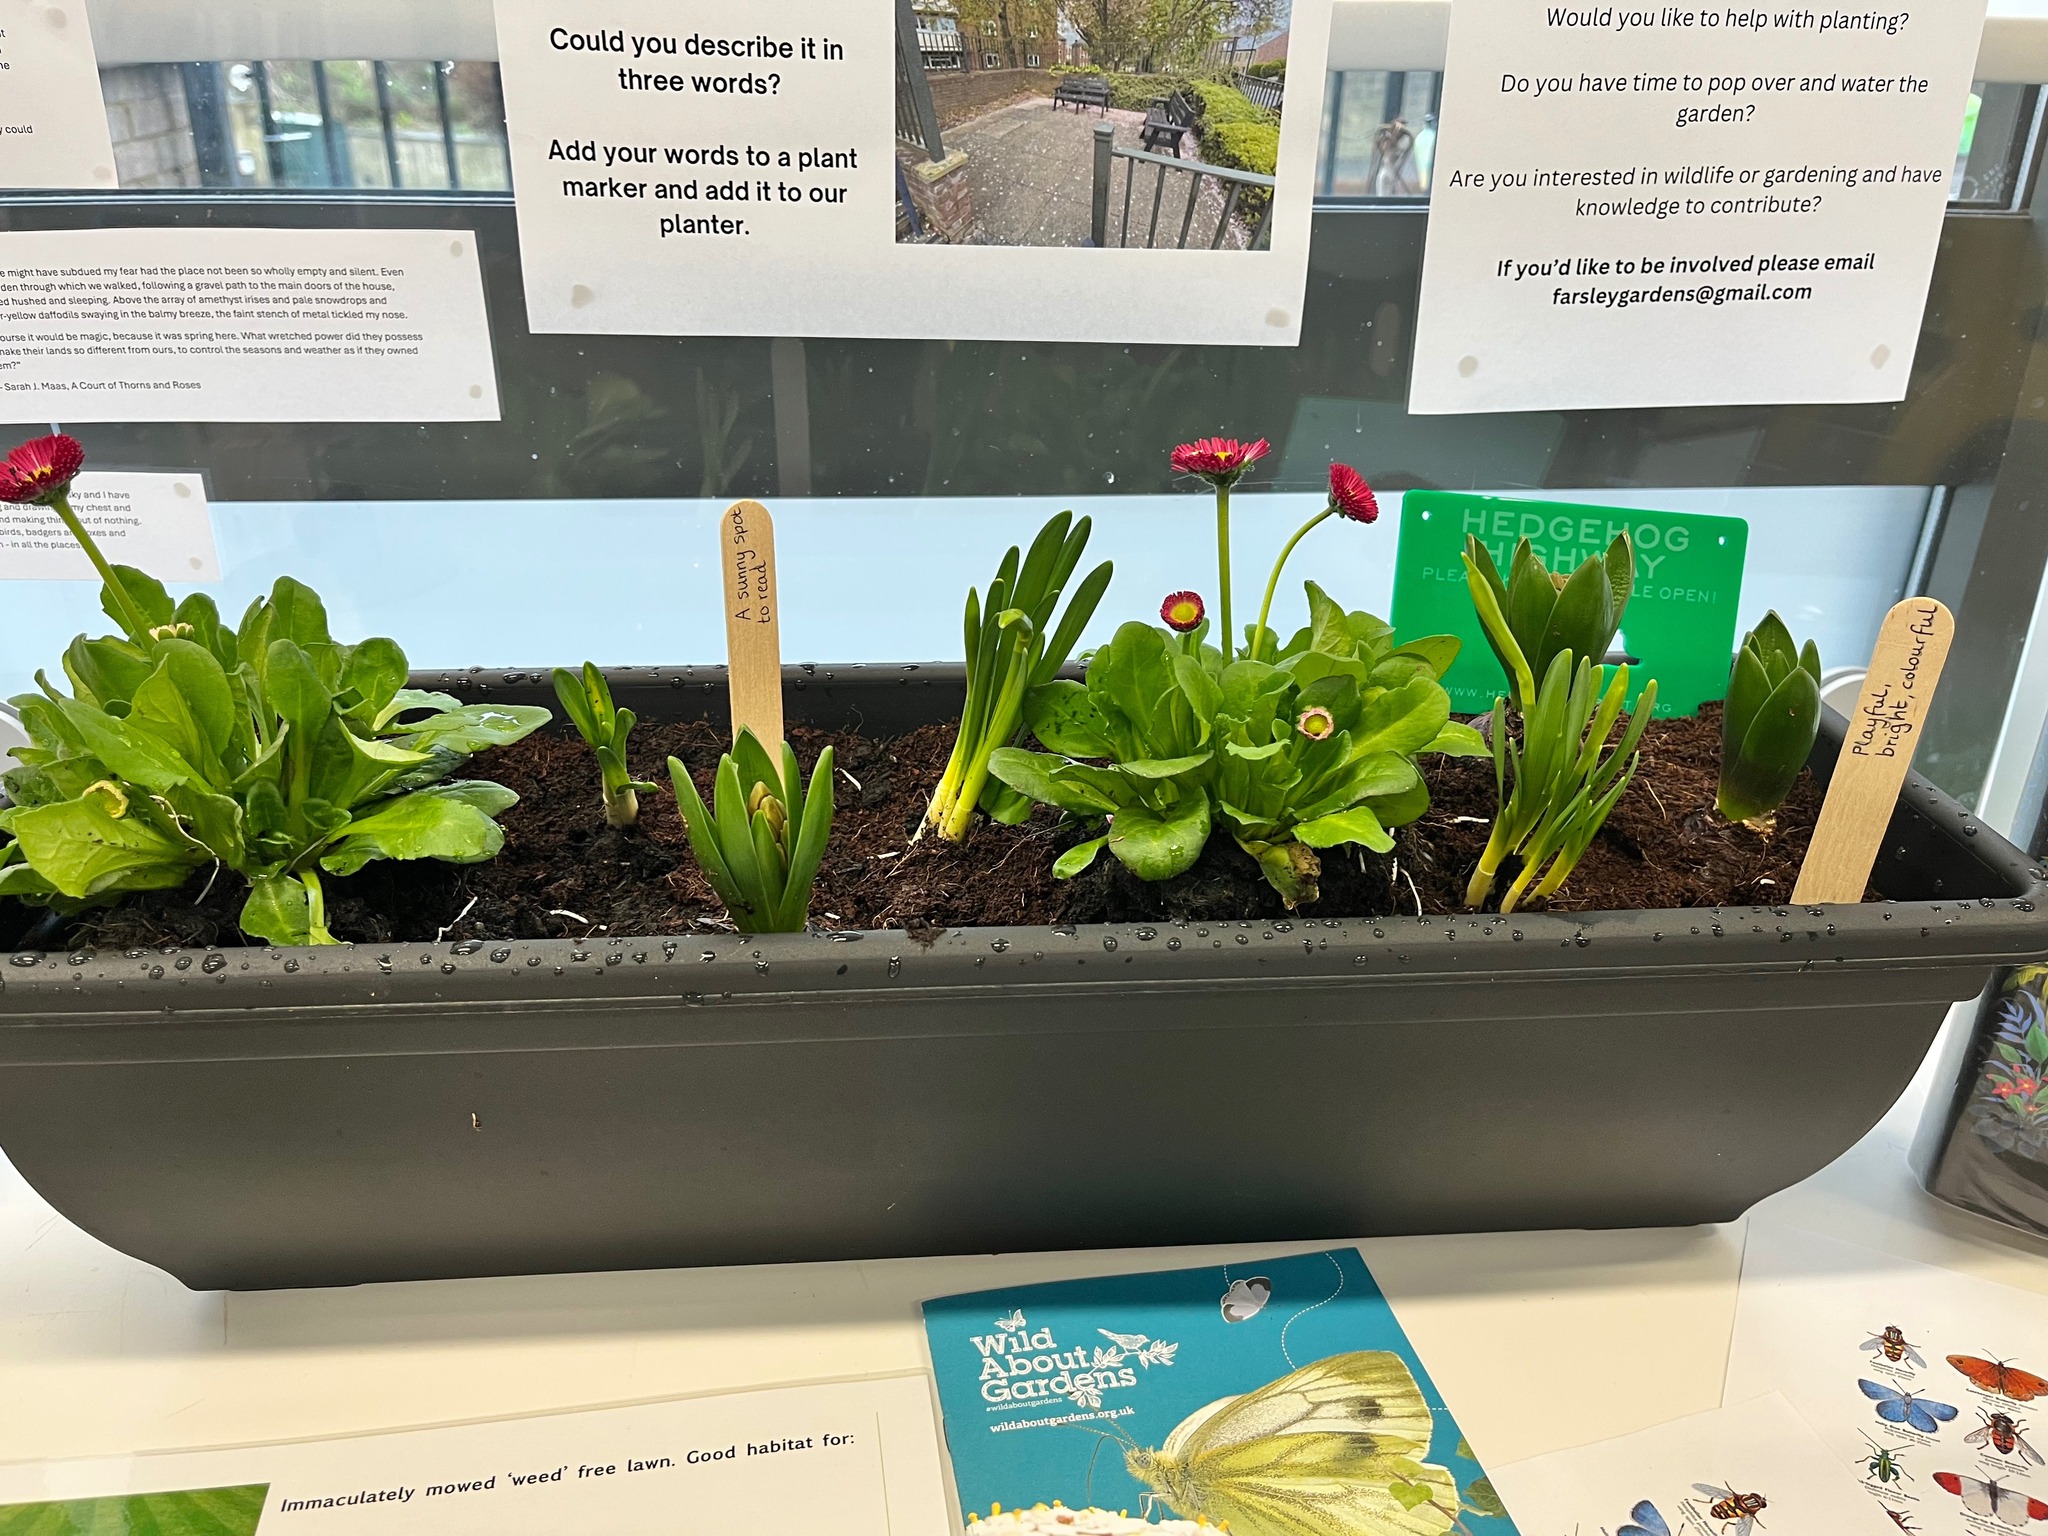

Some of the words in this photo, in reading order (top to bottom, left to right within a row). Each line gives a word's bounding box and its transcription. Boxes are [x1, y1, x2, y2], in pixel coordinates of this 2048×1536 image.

[1547, 7, 1612, 26] Would
[1615, 12, 1654, 31] you
[1661, 7, 1694, 26] like
[1700, 9, 1719, 26] to
[1725, 8, 1767, 32] help
[1774, 9, 1814, 28] with
[1819, 10, 1909, 35] planting?
[550, 27, 624, 52] Could
[630, 36, 676, 58] you
[684, 33, 793, 58] describe
[800, 37, 816, 59] it
[823, 37, 843, 60] in
[618, 67, 684, 91] three
[690, 72, 780, 95] words?
[1501, 74, 1529, 92] Do
[1533, 77, 1572, 97] you
[1579, 72, 1627, 91] have
[1633, 72, 1677, 91] time
[1683, 74, 1702, 91] to
[1707, 77, 1745, 95] pop
[1751, 77, 1795, 91] over
[1799, 73, 1836, 91] and
[1841, 76, 1895, 92] water
[1899, 74, 1928, 93] the
[1675, 103, 1755, 127] garden?
[5, 125, 33, 134] could
[548, 139, 596, 161] Add
[602, 146, 657, 166] your
[663, 144, 738, 165] words
[745, 145, 770, 166] to
[777, 151, 790, 167] a
[798, 147, 857, 172] plant
[562, 176, 647, 198] marker
[654, 179, 697, 199] and
[705, 180, 749, 201] add
[756, 180, 771, 201] it
[777, 181, 801, 202] to
[809, 187, 847, 203] our
[1449, 169, 1484, 187] Are
[1488, 173, 1527, 192] you
[1533, 167, 1635, 186] interested
[1640, 166, 1657, 184] in
[1664, 165, 1734, 184] wildlife
[1739, 170, 1760, 183] or
[1762, 165, 1858, 188] gardening
[1862, 165, 1897, 182] and
[1901, 165, 1941, 182] have
[1575, 197, 1679, 219] knowledge
[1685, 198, 1704, 214] to
[1710, 195, 1822, 213] contribute?
[660, 213, 749, 238] planter.
[7, 268, 34, 279] might
[34, 268, 58, 276] have
[59, 267, 101, 276] subdued
[103, 268, 118, 277] my
[119, 266, 138, 275] fear
[139, 266, 158, 275] had
[159, 266, 176, 275] the
[177, 266, 205, 276] place
[206, 267, 223, 275] not
[223, 266, 248, 275] been
[250, 267, 262, 275] so
[263, 266, 295, 277] wholly
[296, 267, 327, 277] empty
[328, 267, 347, 275] and
[348, 267, 379, 276] silent.
[380, 267, 404, 276] Even
[1497, 259, 1513, 276] If
[1576, 257, 1610, 275] like
[1615, 259, 1635, 274] to
[1640, 256, 1664, 273] be
[1669, 254, 1754, 273] involved
[1757, 254, 1819, 276] please
[1824, 252, 1875, 270] email
[10, 296, 46, 305] hushed
[48, 296, 66, 305] and
[68, 295, 110, 306] sleeping.
[112, 295, 142, 304] Above
[142, 295, 159, 304] the
[160, 296, 184, 305] array
[186, 295, 196, 303] of
[198, 295, 243, 305] amethyst
[244, 294, 270, 304] irises
[272, 295, 290, 304] and
[292, 295, 313, 305] pale
[314, 296, 367, 306] snowdrops
[368, 296, 387, 304] and
[19, 282, 56, 293] through
[57, 281, 86, 290] which
[102, 281, 140, 290] walked,
[141, 280, 186, 291] following
[194, 280, 223, 291] gravel
[224, 281, 247, 291] path
[248, 281, 259, 289] to
[259, 281, 276, 289] the
[277, 281, 302, 289] main
[303, 281, 332, 290] doors
[333, 281, 342, 290] of
[344, 281, 361, 290] the
[361, 282, 395, 291] house,
[1552, 283, 1812, 308] farsleygardens@gmail.com
[239, 331, 267, 340] What
[267, 331, 312, 340] wretched
[314, 333, 343, 342] power
[345, 332, 360, 340] did
[361, 332, 383, 342] they
[384, 333, 423, 342] possess
[3, 382, 31, 391] Sarah
[33, 382, 40, 390] J.
[40, 382, 69, 390] Maas,
[71, 381, 78, 389] A
[78, 381, 106, 389] Court
[107, 381, 116, 389] of
[118, 380, 151, 389] Thorns
[152, 380, 171, 389] and
[172, 380, 201, 389] Roses
[731, 507, 748, 544] spot
[1462, 508, 1689, 552] HEDGEHOG
[736, 550, 756, 600] sunny
[749, 559, 768, 600] read
[735, 608, 751, 620] A
[758, 606, 771, 624] to
[1900, 604, 1937, 690] colourful
[970, 1327, 1057, 1357] Wild
[979, 1346, 1090, 1380] About
[981, 1367, 1137, 1402] Gardens
[989, 1406, 1135, 1433] wildaboutgardens.org.uk
[280, 1486, 415, 1512] Immaculately
[425, 1475, 495, 1496] mowed
[578, 1464, 616, 1478] free
[627, 1458, 675, 1472] lawn.
[686, 1445, 735, 1464] Good
[747, 1437, 813, 1456] habitat
[822, 1433, 854, 1446] for:
